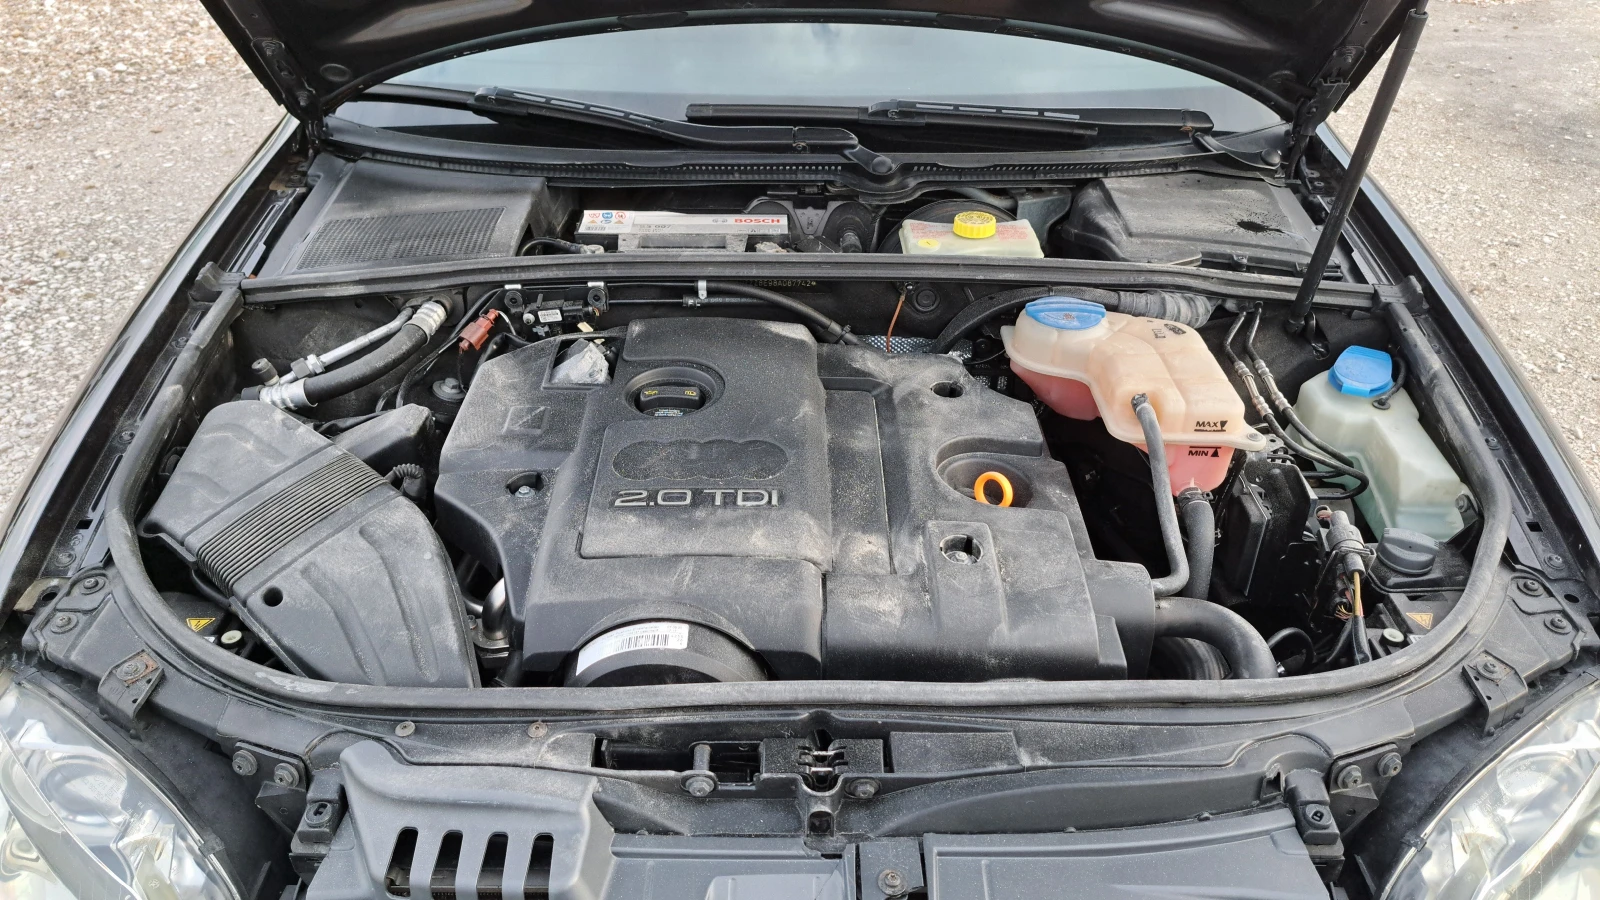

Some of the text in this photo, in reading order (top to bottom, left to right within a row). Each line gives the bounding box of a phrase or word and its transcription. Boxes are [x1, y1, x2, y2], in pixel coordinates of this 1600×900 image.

[1195, 420, 1219, 428] MAX
[614, 489, 780, 507] 2.0 TDI
